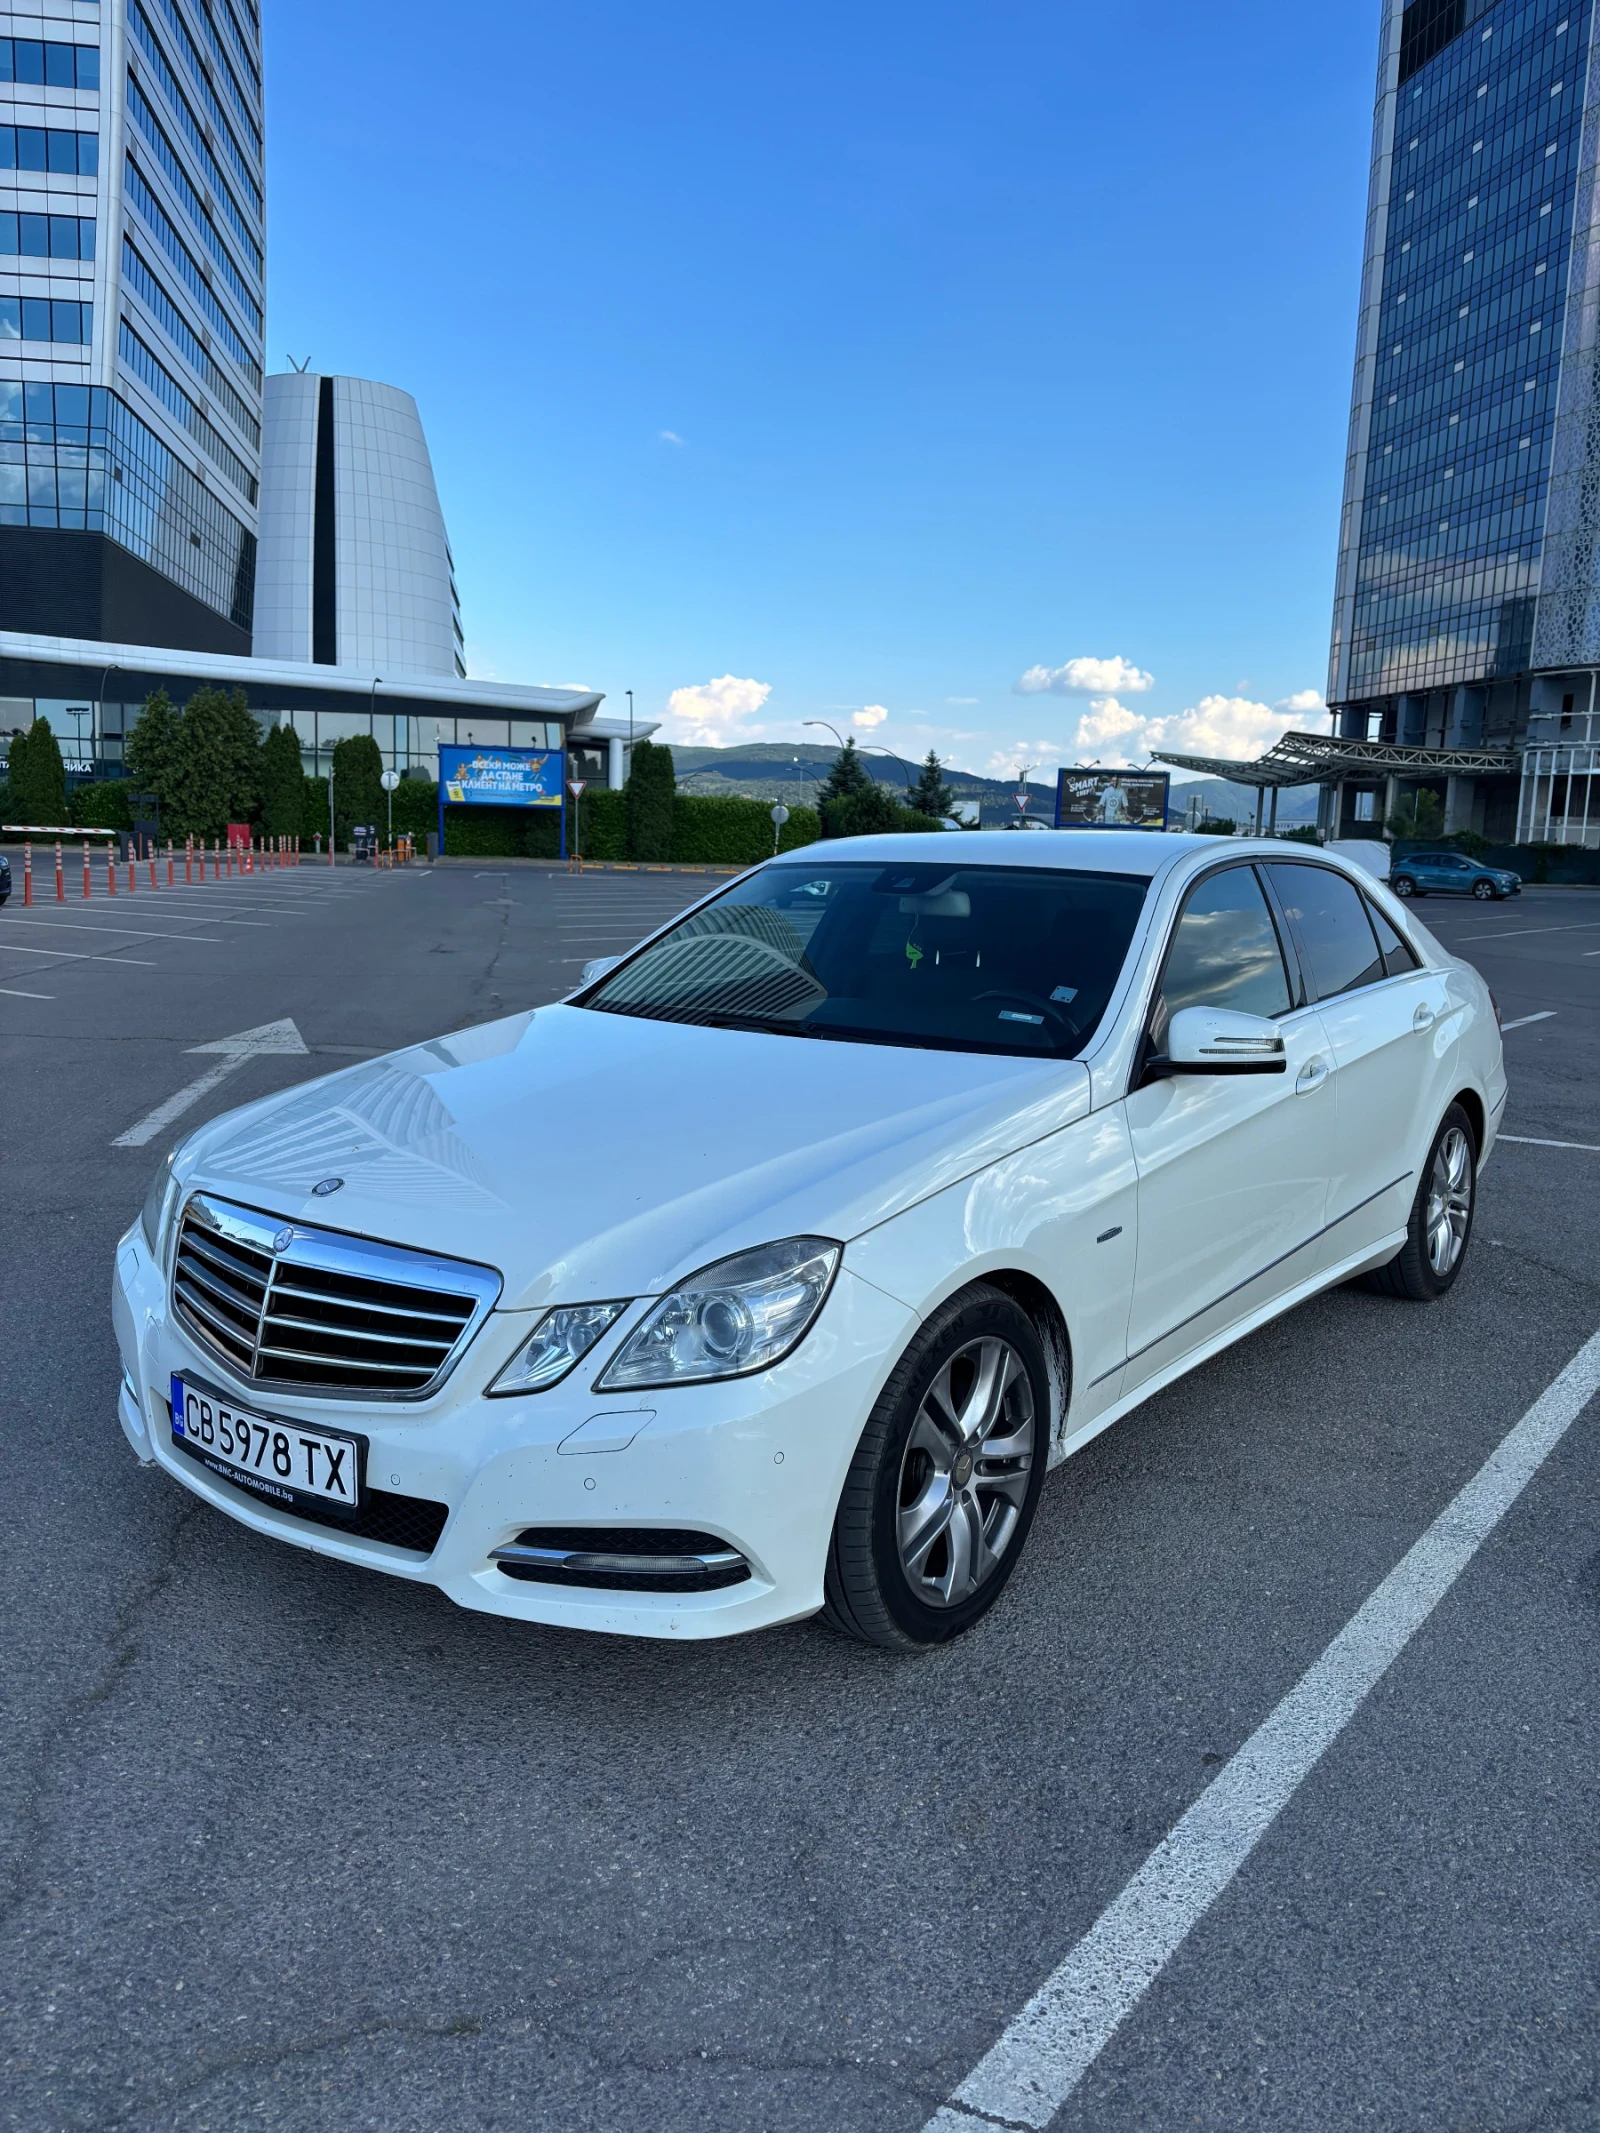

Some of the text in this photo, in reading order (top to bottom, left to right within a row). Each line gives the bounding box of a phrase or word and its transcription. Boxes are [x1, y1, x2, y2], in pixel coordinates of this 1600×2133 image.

[502, 762, 531, 771] МОЖЕ
[480, 771, 524, 782] ДА СТАНЕ
[461, 780, 498, 790] КЛИЕНТ
[498, 781, 511, 791] НА
[511, 782, 543, 792] МЕТРО
[1069, 776, 1099, 793] SMART
[907, 1315, 965, 1399] NEXEN
[174, 1411, 184, 1427] BG
